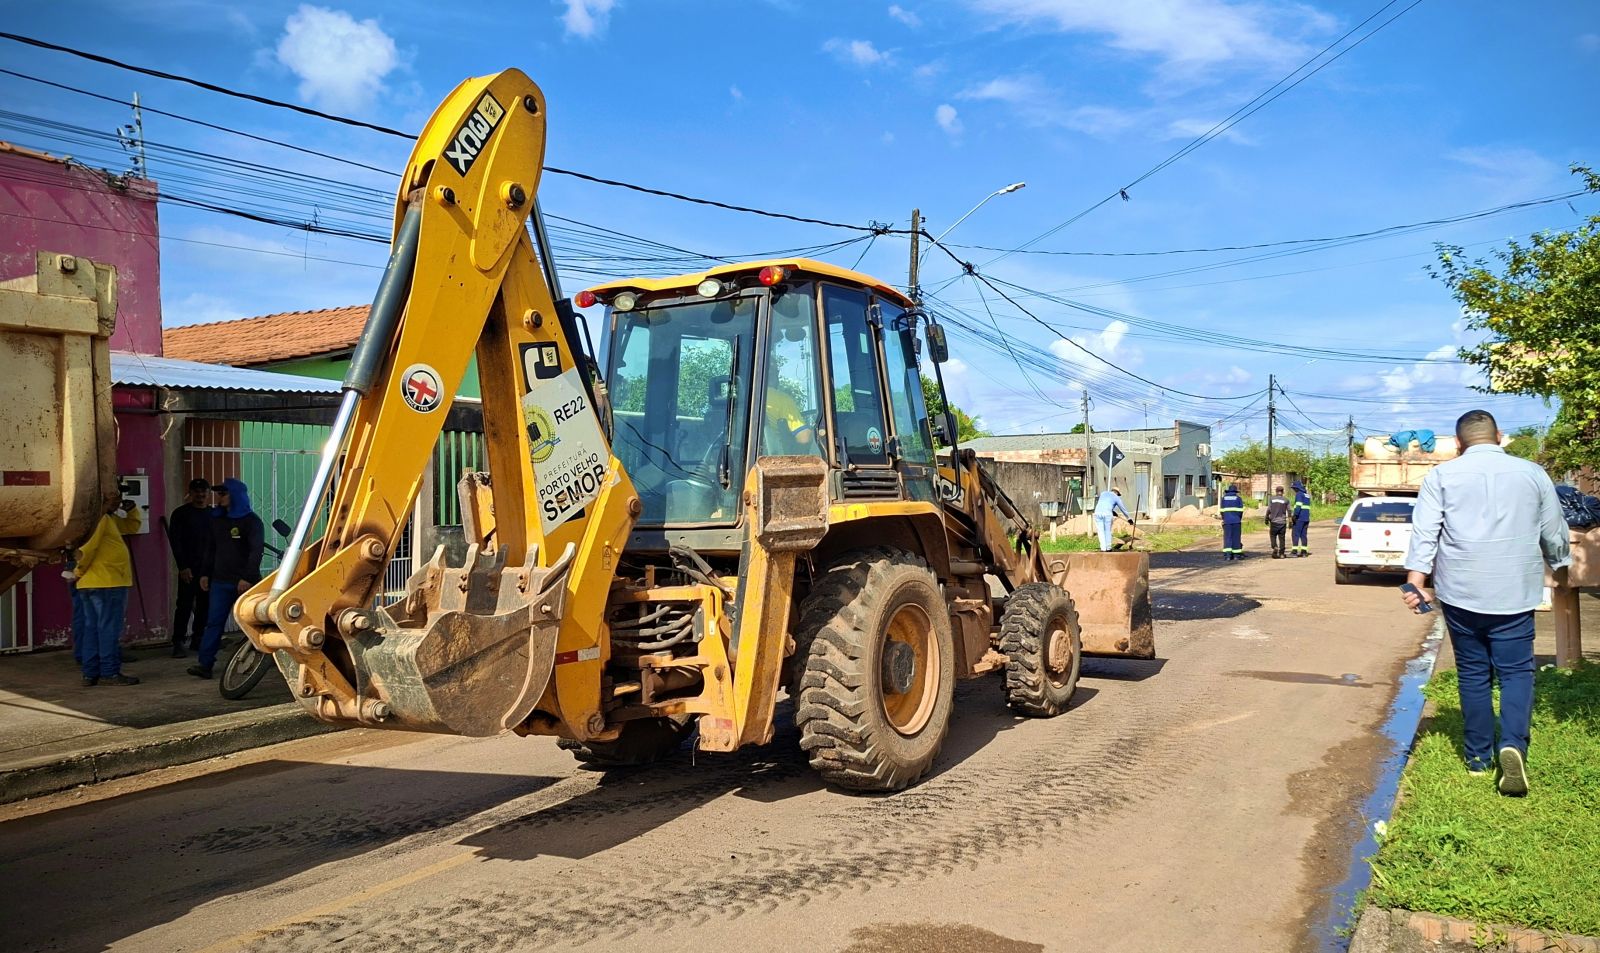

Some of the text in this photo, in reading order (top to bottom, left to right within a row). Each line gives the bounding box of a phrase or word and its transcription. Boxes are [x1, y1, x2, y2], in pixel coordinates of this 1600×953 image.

[554, 395, 586, 425] RE22
[539, 453, 598, 500] PORTO VELHO
[544, 448, 587, 480] PREFEITURA
[543, 464, 606, 521] SEMOB
